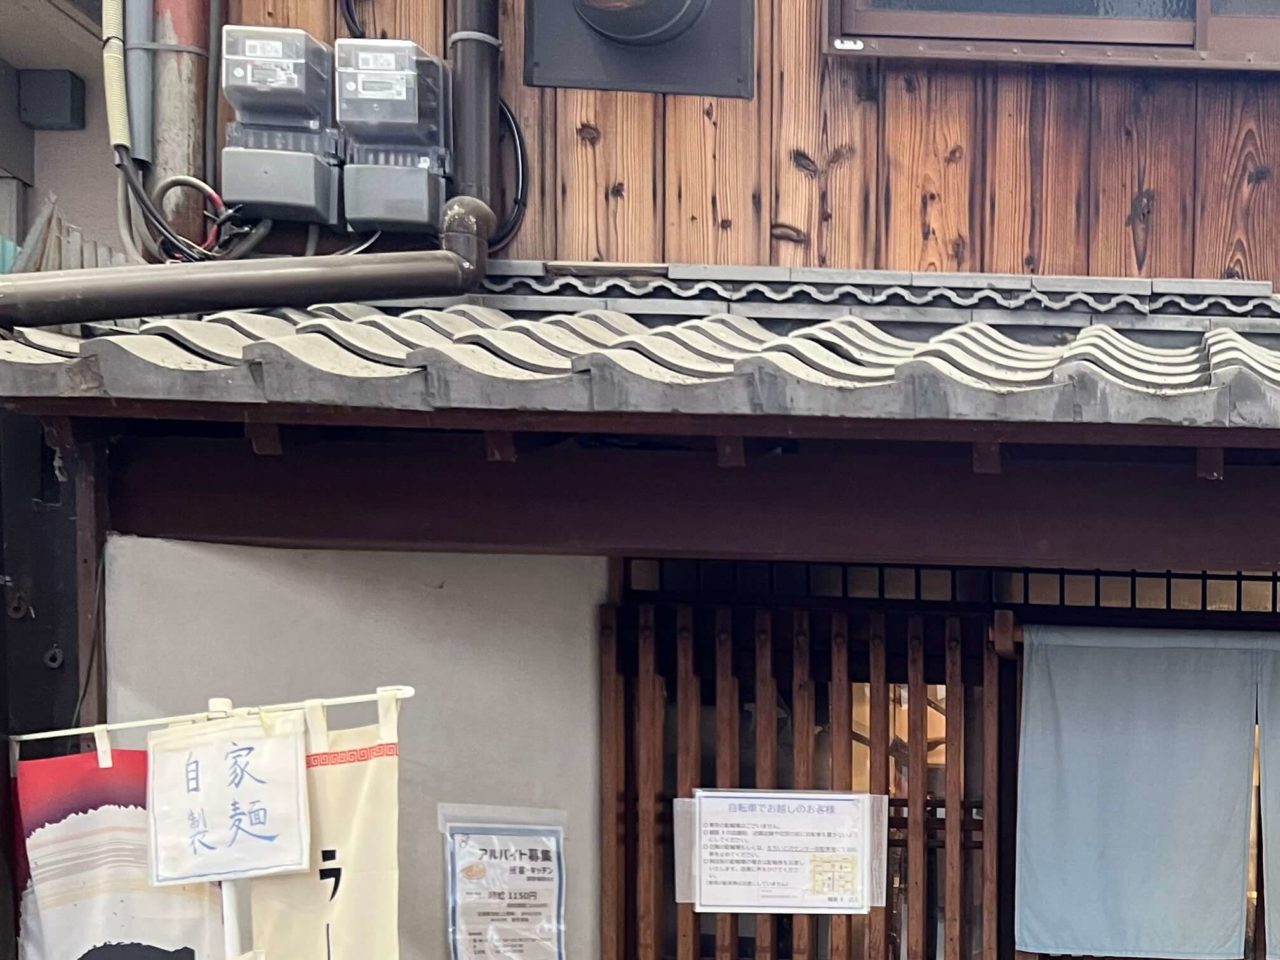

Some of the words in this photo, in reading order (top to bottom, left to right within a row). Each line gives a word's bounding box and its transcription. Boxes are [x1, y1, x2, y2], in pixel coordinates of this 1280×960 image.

[728, 803, 836, 815] 自転車でお越しのお客様
[478, 848, 553, 862] アルバイト募集
